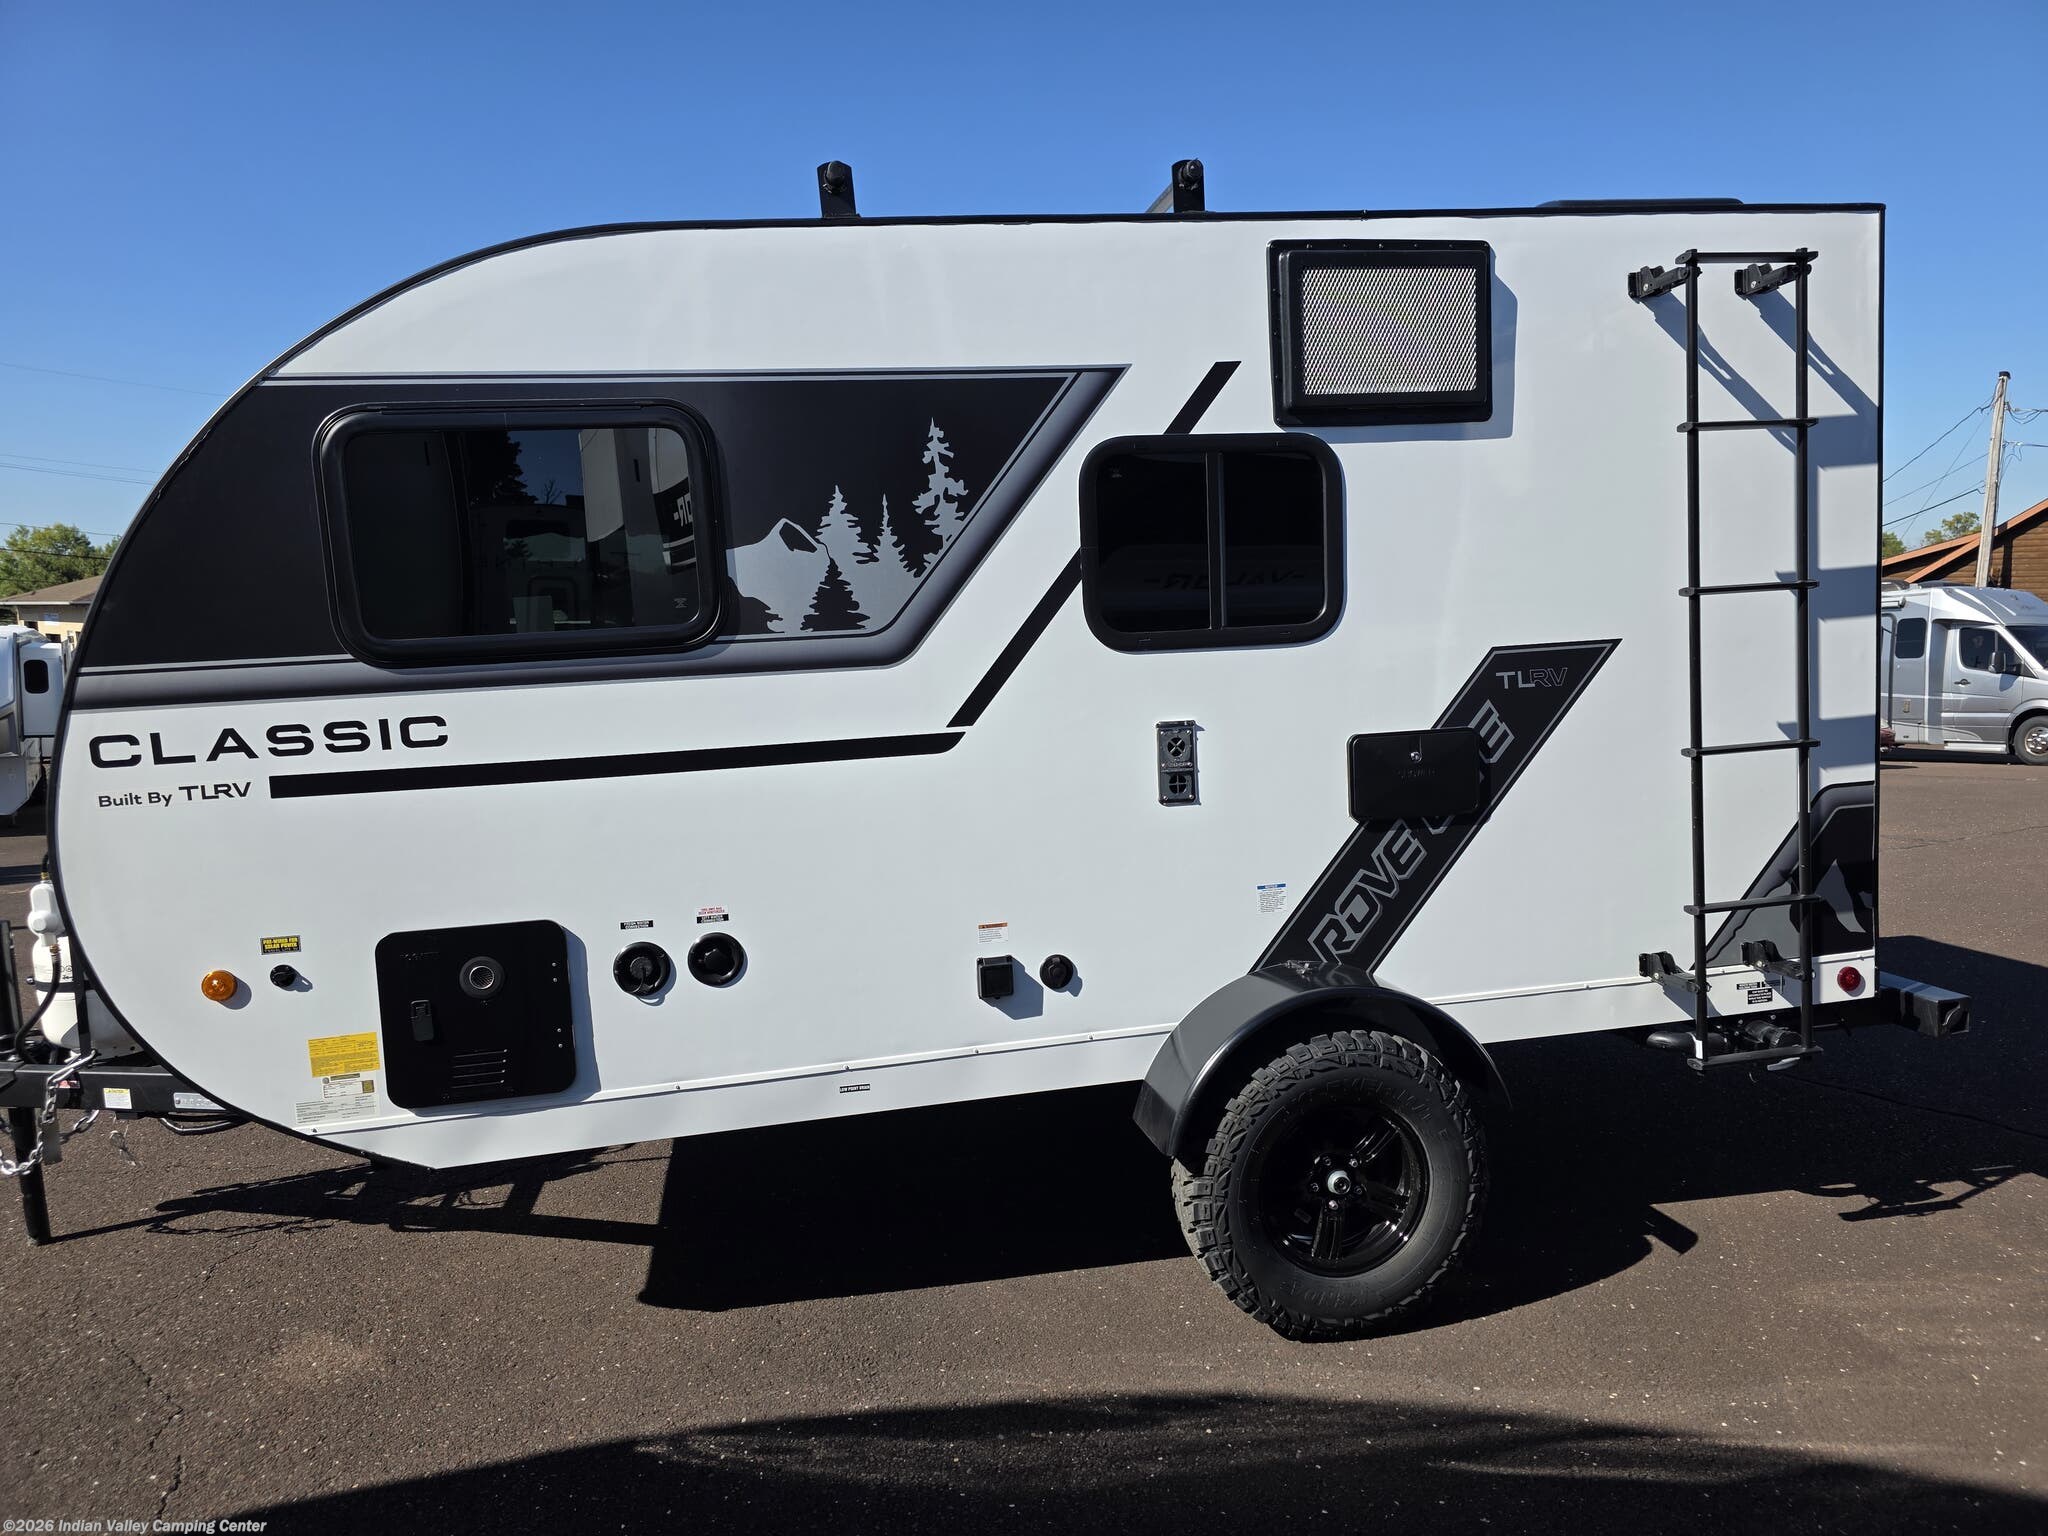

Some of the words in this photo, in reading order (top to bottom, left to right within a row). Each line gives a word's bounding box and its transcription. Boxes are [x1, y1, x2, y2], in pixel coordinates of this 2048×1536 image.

[1495, 667, 1568, 689] TLRV
[88, 715, 449, 769] CLASSIC
[98, 792, 142, 808] Built
[148, 791, 173, 807] By
[178, 781, 252, 802] TLRV
[1307, 819, 1428, 965] ROVE
